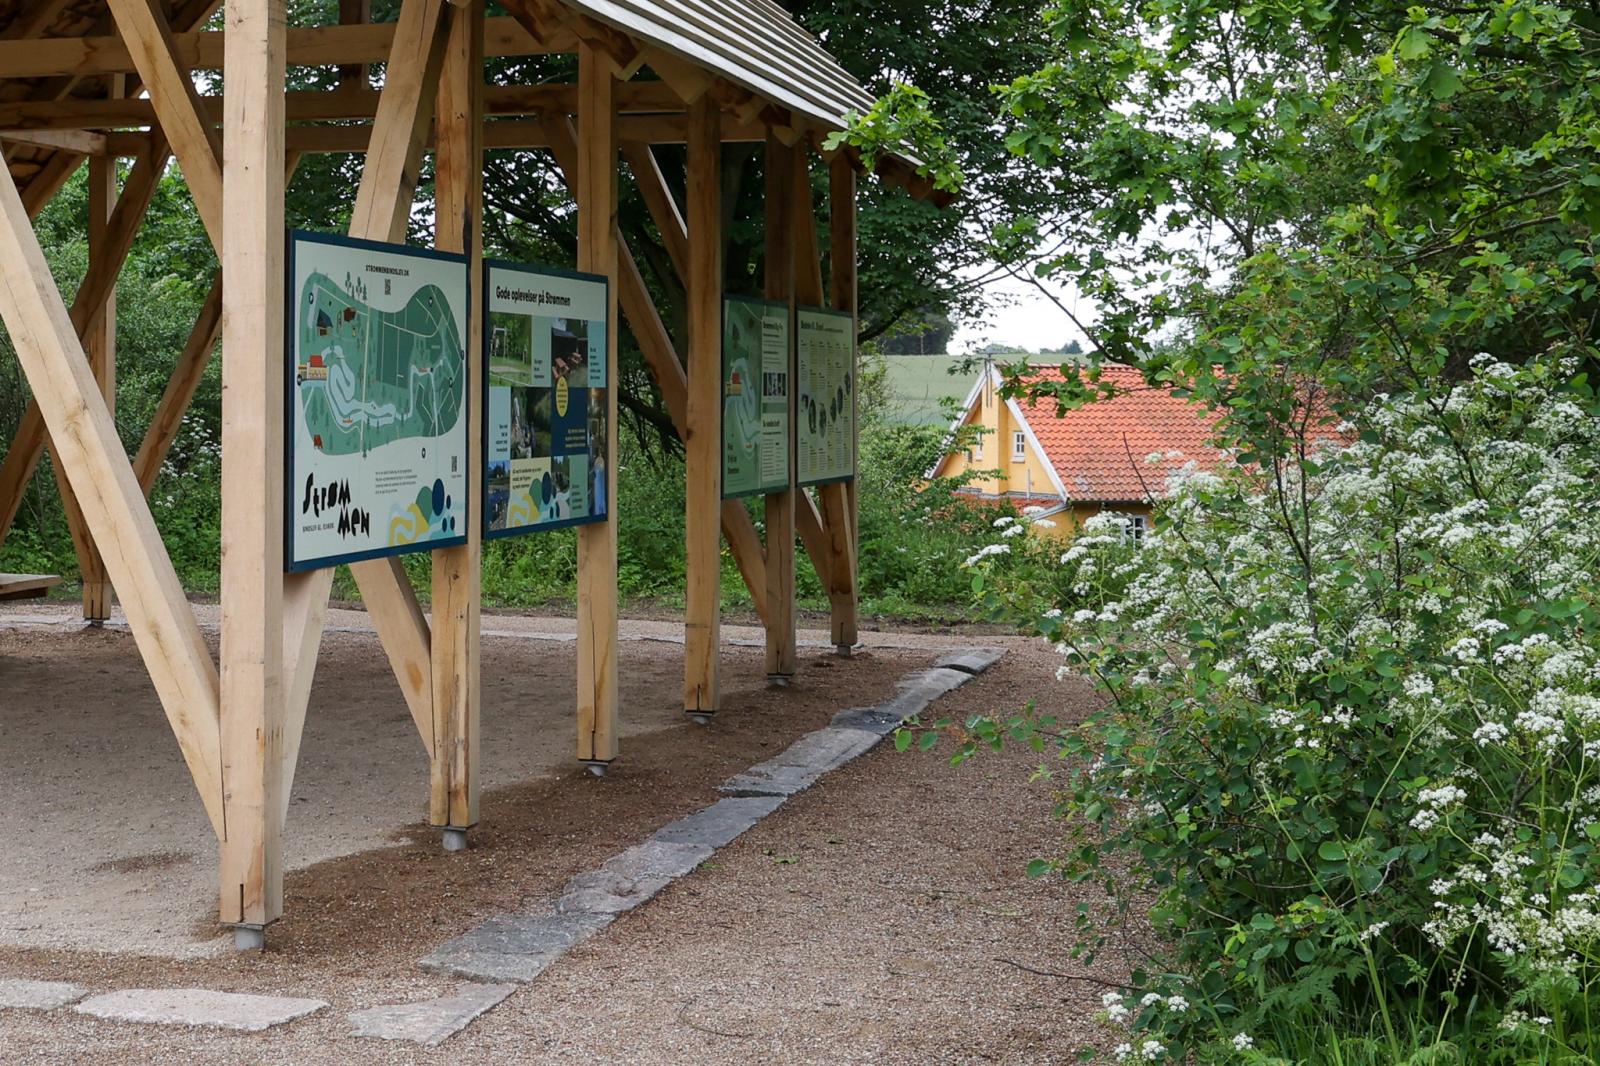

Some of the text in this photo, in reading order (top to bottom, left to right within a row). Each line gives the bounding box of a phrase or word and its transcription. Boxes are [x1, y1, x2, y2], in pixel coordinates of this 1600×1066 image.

[496, 285, 510, 299] Gode
[511, 288, 537, 303] oplevelser
[538, 289, 545, 306] på
